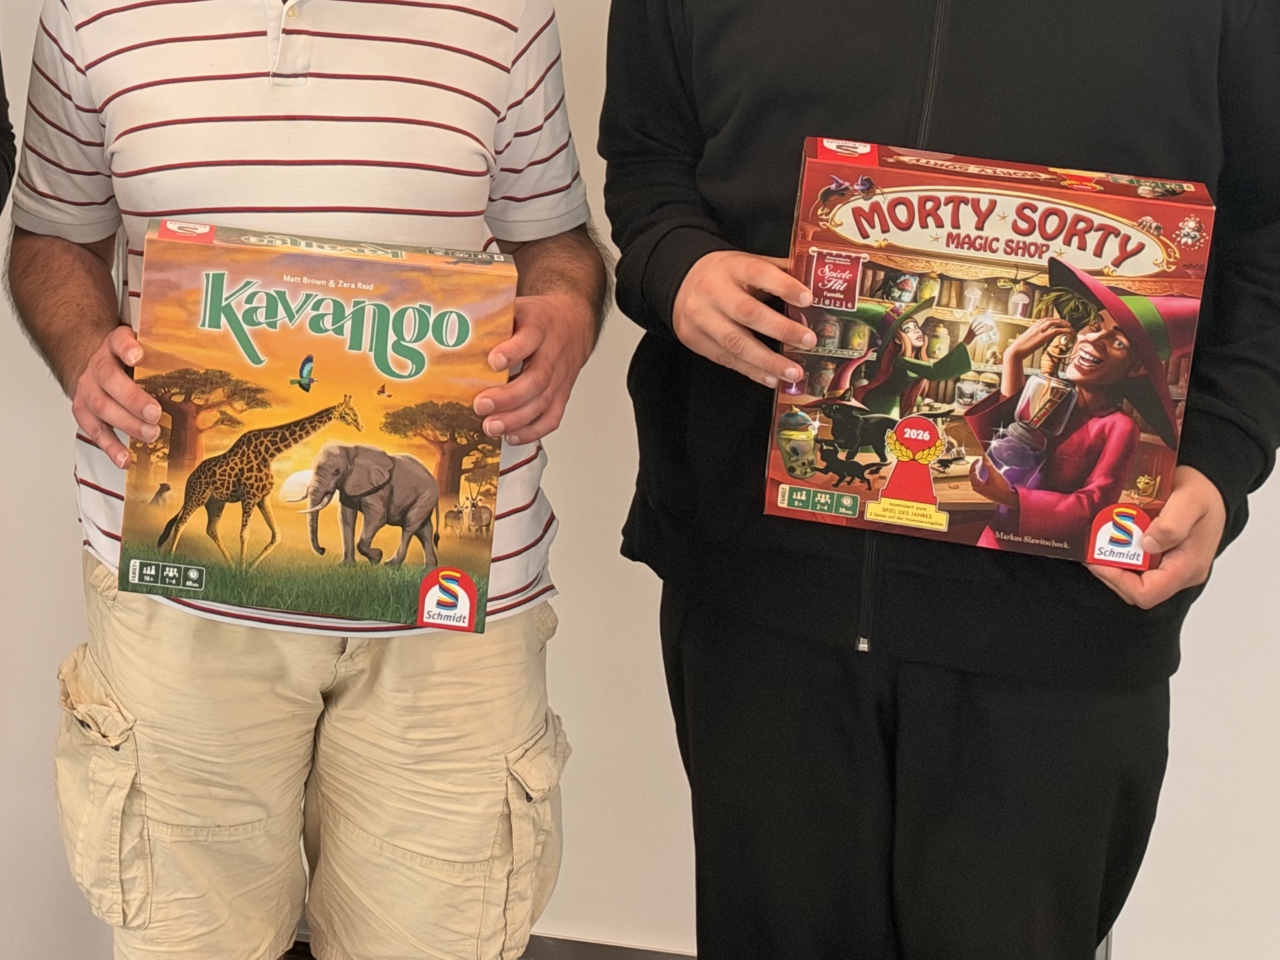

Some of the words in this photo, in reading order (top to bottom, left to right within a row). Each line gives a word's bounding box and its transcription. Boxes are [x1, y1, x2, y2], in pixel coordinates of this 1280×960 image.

[851, 194, 997, 240] MORTY
[1011, 202, 1145, 268] SORTY
[945, 232, 1000, 253] MAGIC
[1003, 239, 1050, 259] SHOP
[817, 264, 853, 280] Spiele
[283, 274, 301, 283] Matt
[302, 276, 326, 286] Brown
[327, 279, 336, 288] &
[337, 280, 355, 289] Zara
[357, 282, 374, 291] Reid
[199, 271, 470, 380] Kavango
[903, 428, 930, 441] 2026
[910, 511, 932, 519] JAHRES
[994, 531, 1022, 542] Markus
[1096, 546, 1141, 562] Schmidt
[425, 610, 467, 623] Schmidt
